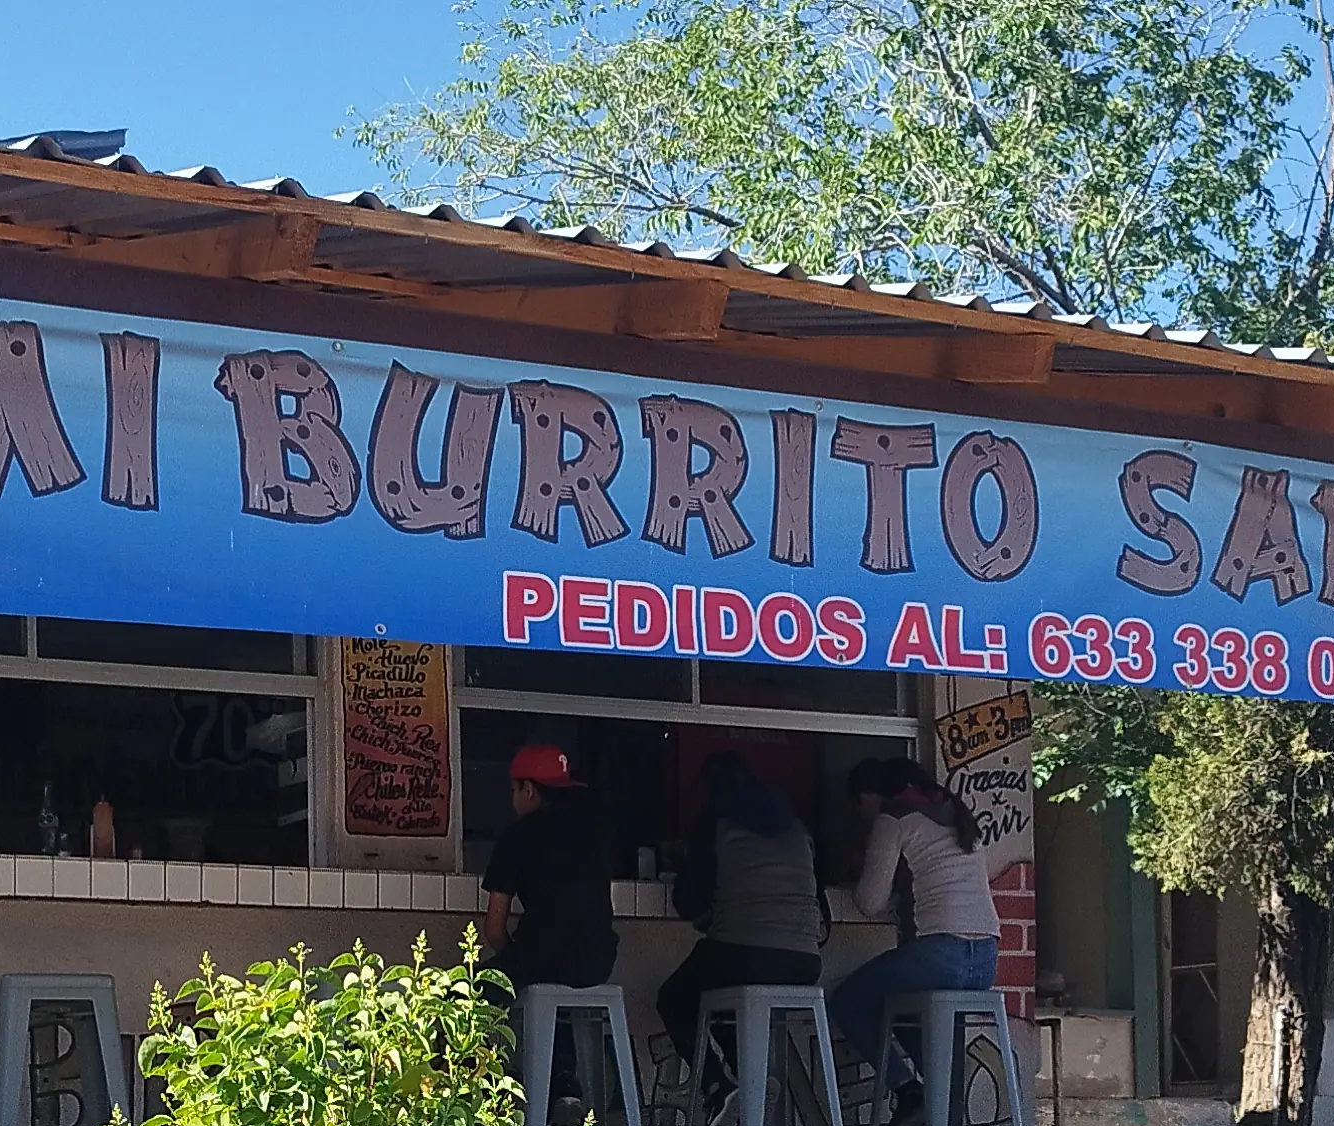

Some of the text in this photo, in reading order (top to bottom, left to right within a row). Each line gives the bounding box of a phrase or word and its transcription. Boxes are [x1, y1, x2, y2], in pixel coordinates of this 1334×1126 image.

[214, 348, 1039, 584] BURRITO
[502, 570, 867, 666] PEDIDOS
[886, 603, 1008, 675] AL:
[1028, 611, 1156, 684] 633
[1172, 622, 1291, 697] 338
[373, 643, 434, 668] Huevo
[347, 662, 426, 684] Picadillo
[352, 681, 426, 701] Machaca
[355, 700, 422, 717] Chorizo
